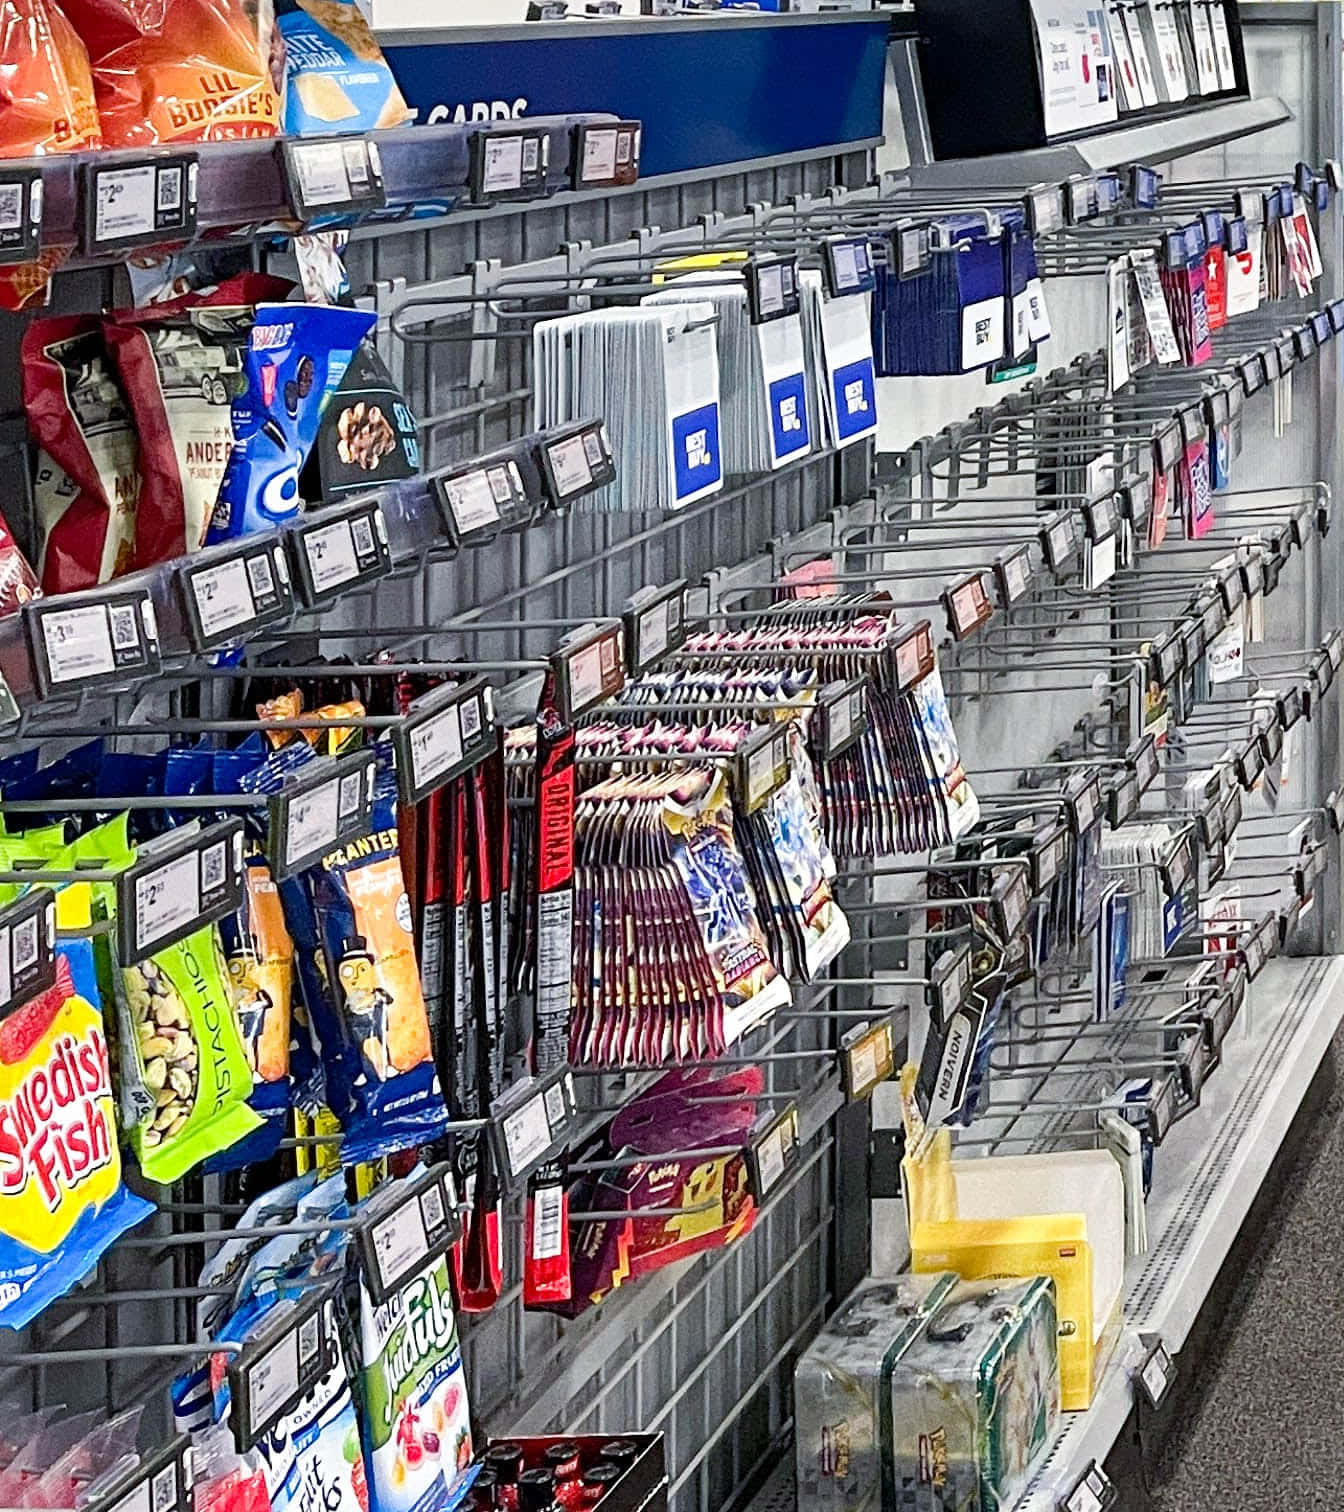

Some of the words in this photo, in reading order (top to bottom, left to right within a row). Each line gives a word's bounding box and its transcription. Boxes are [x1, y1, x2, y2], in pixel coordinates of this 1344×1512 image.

[200, 72, 241, 95] LIL
[286, 48, 346, 74] HEDDAR
[186, 441, 232, 465] ANDER
[546, 783, 570, 874] ORIGINAL
[939, 1029, 963, 1101] NOIVERN
[0, 1029, 112, 1188] Swedish
[30, 1098, 111, 1205] Fish
